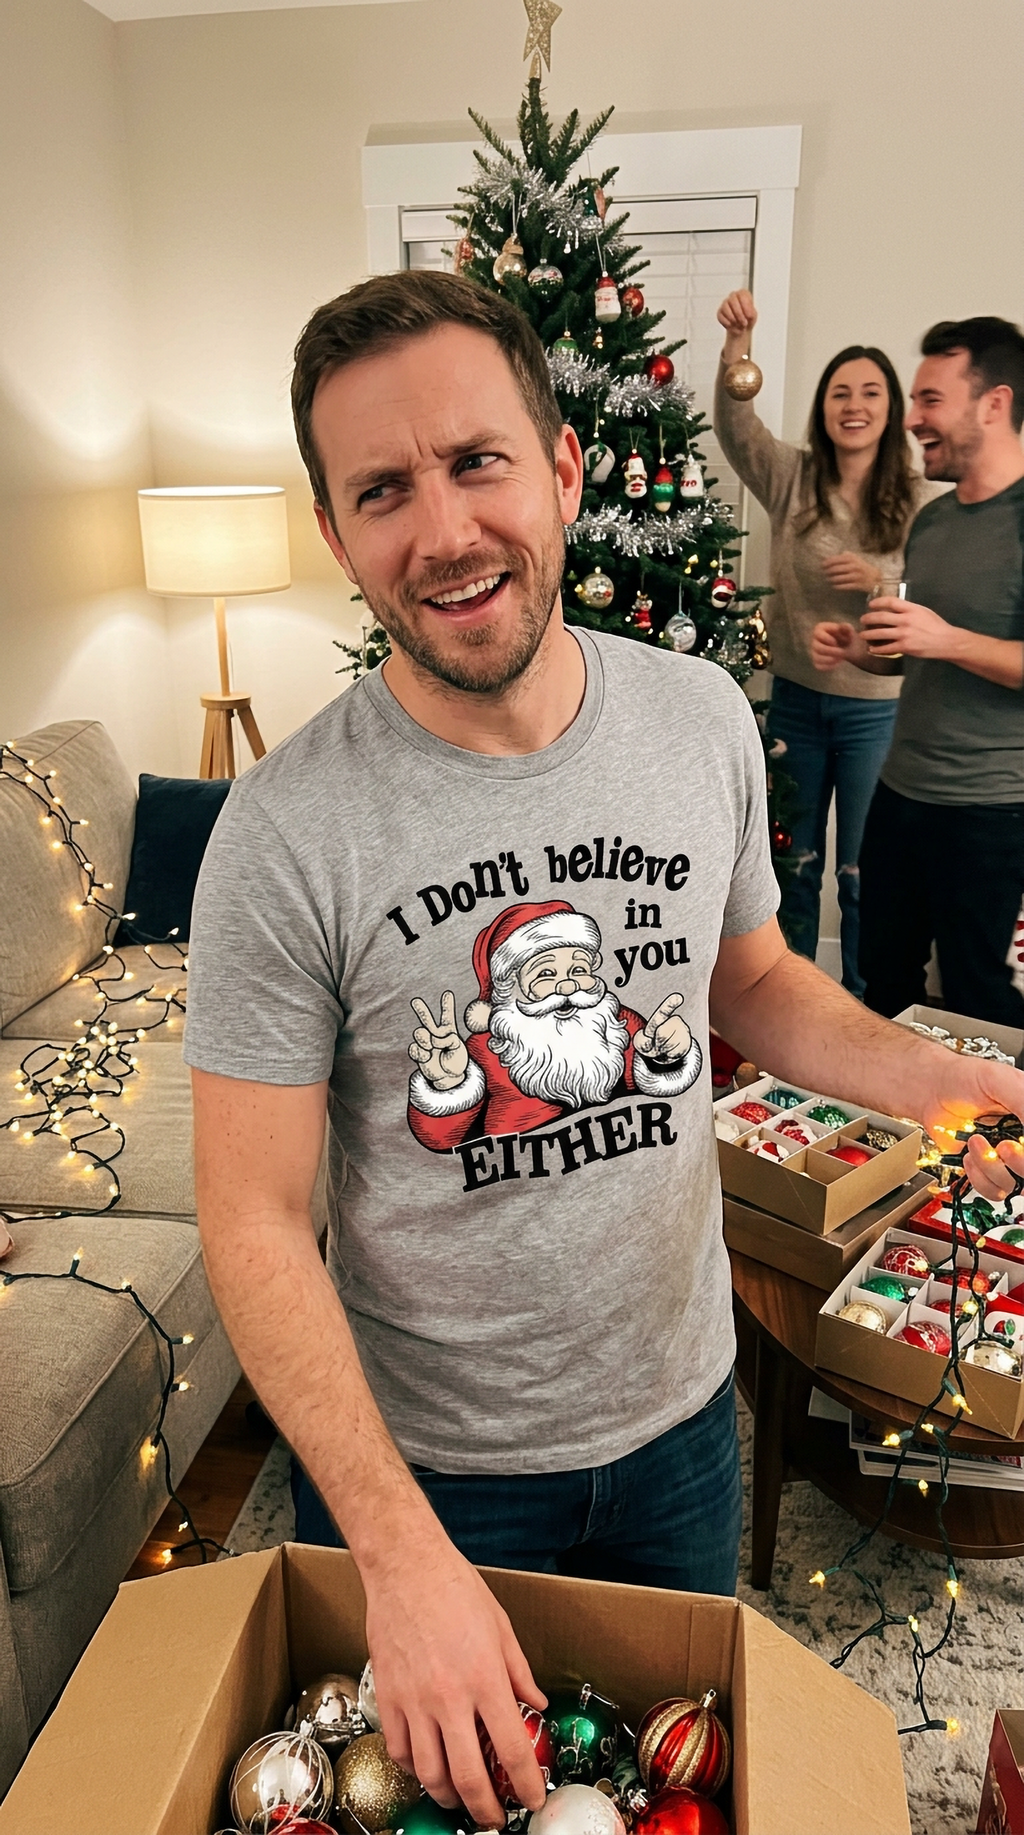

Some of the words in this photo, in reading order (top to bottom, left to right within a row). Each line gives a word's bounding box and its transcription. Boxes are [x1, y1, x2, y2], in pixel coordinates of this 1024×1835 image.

[386, 905, 420, 946] I
[416, 851, 530, 927] Don't
[544, 836, 691, 892] believe
[625, 898, 662, 930] in
[614, 937, 691, 988] you
[453, 1101, 678, 1193] EITHER
